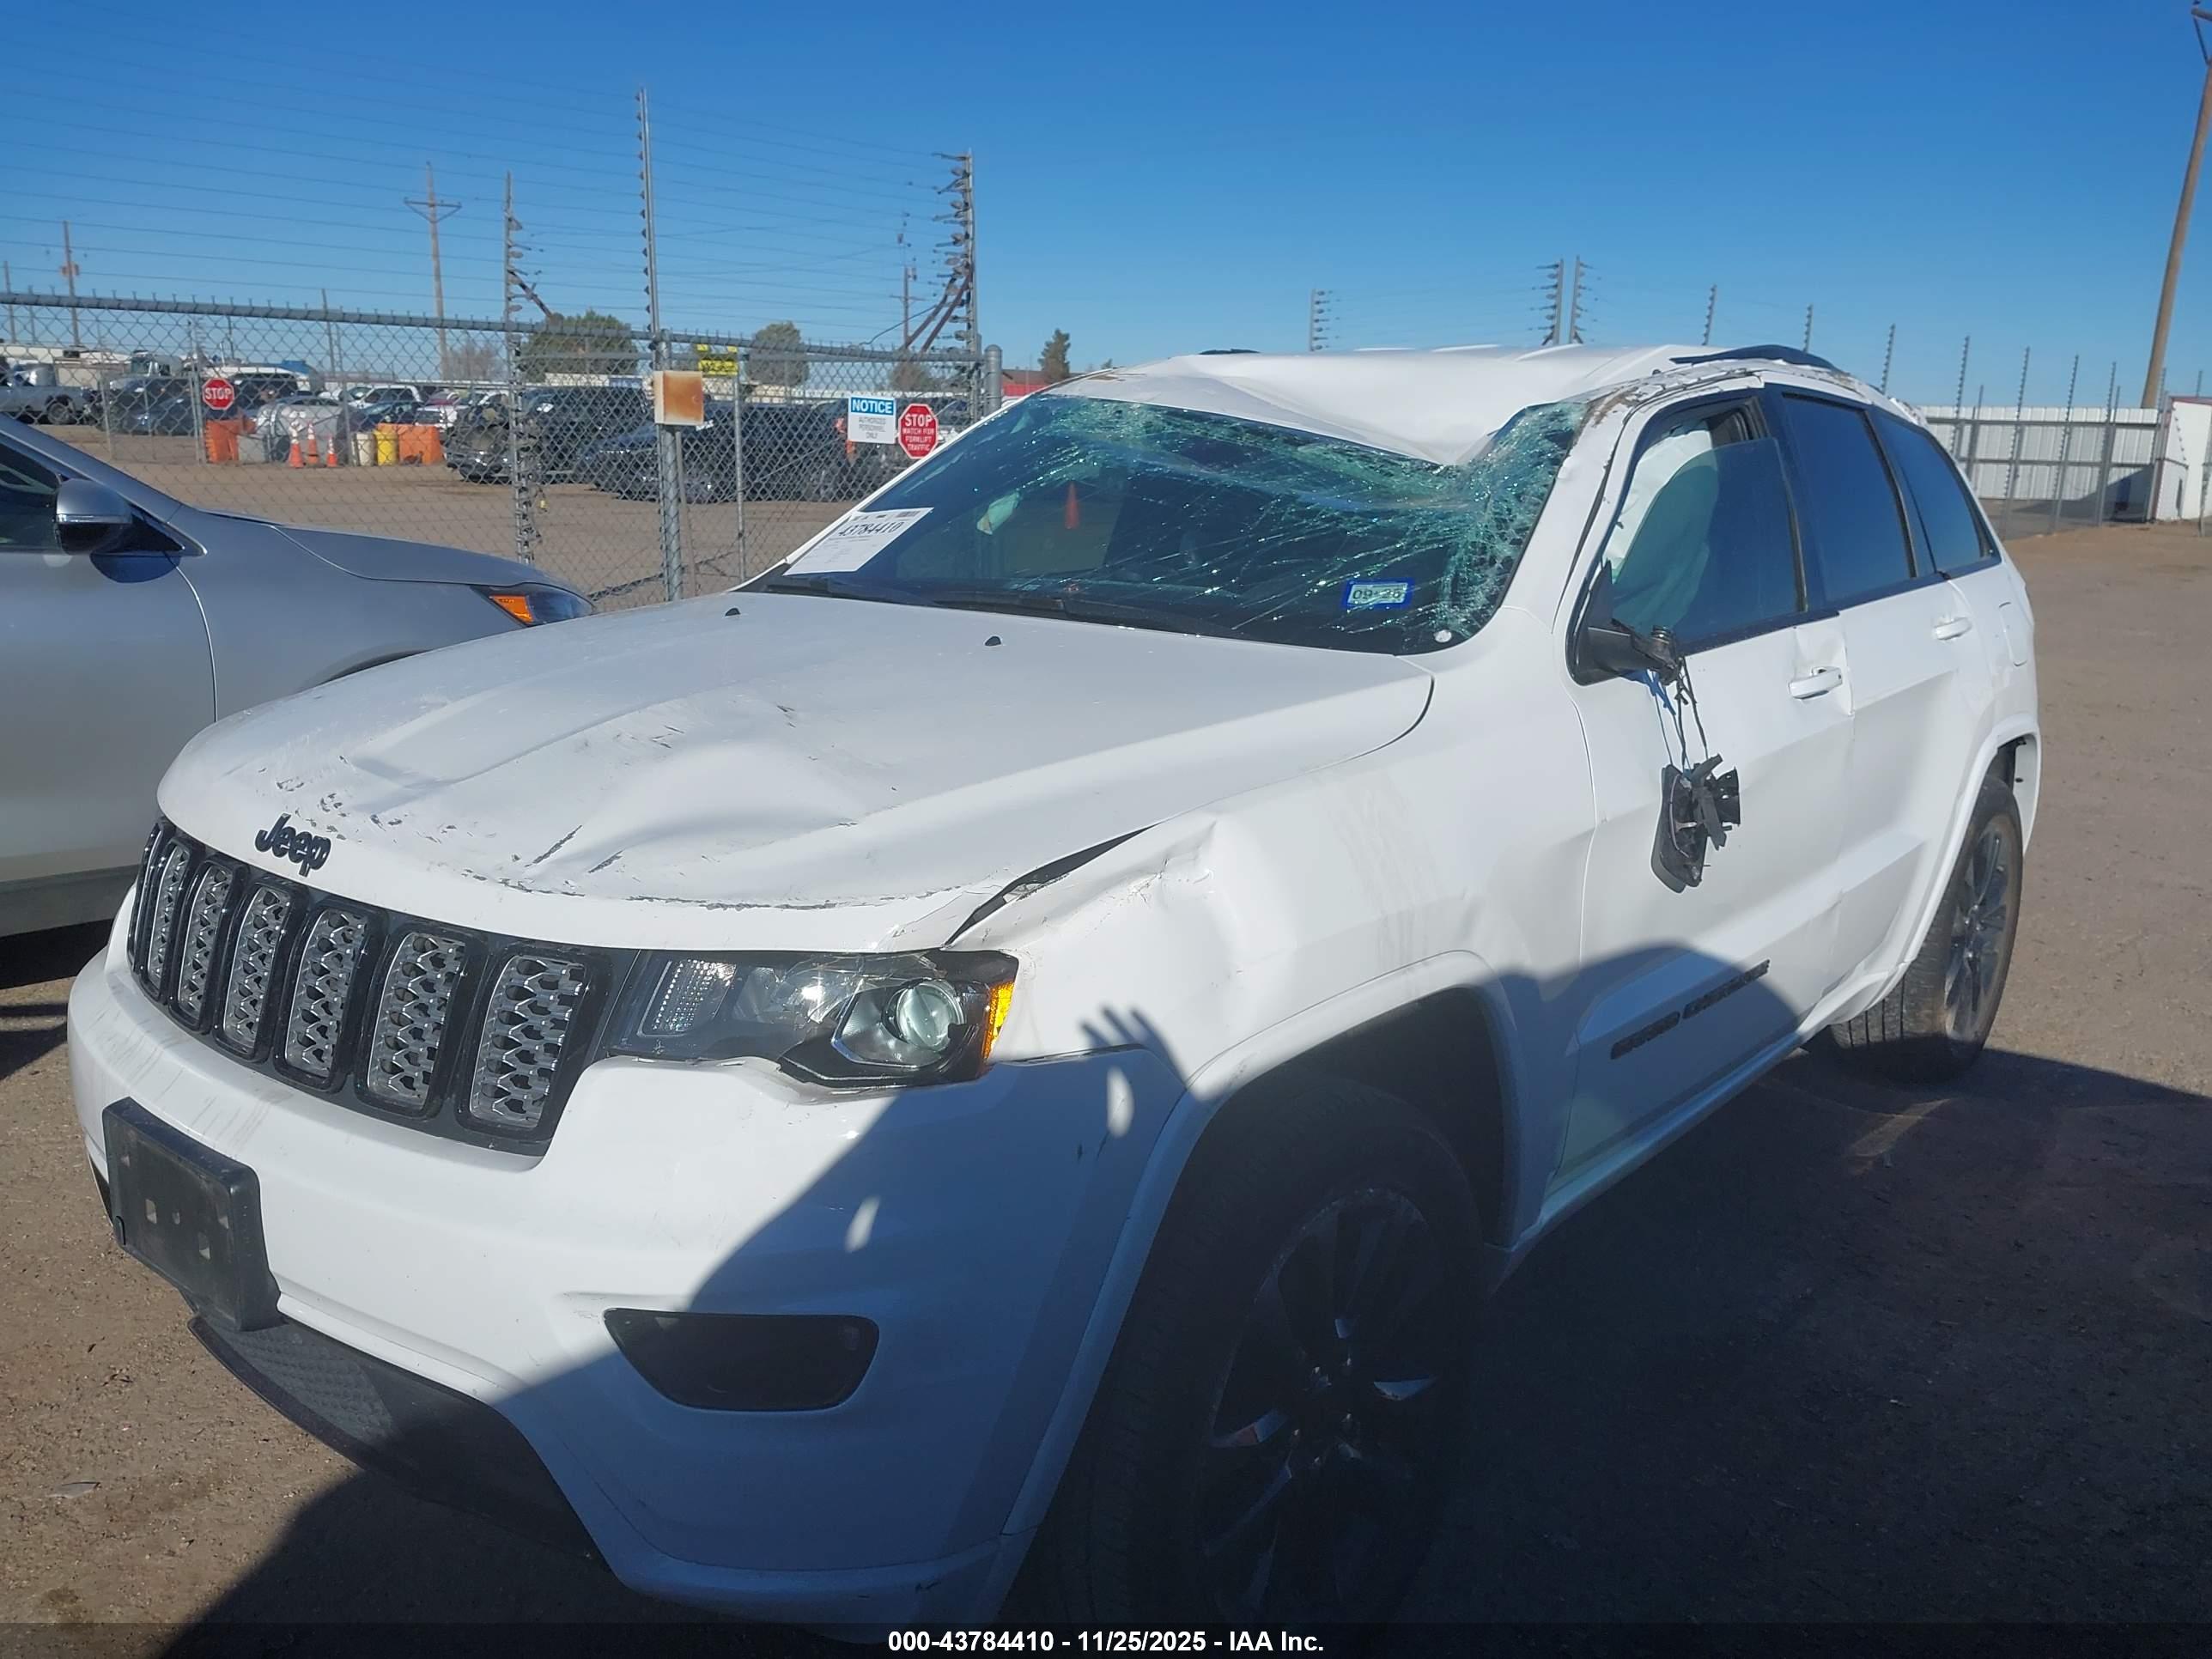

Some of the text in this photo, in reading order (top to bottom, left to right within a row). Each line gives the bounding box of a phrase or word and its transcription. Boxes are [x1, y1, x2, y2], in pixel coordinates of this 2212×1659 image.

[205, 387, 232, 400] STOP
[852, 398, 893, 414] NOTICE
[904, 413, 933, 427] STOP
[838, 520, 905, 537] 43784410
[255, 812, 331, 877] Jeep
